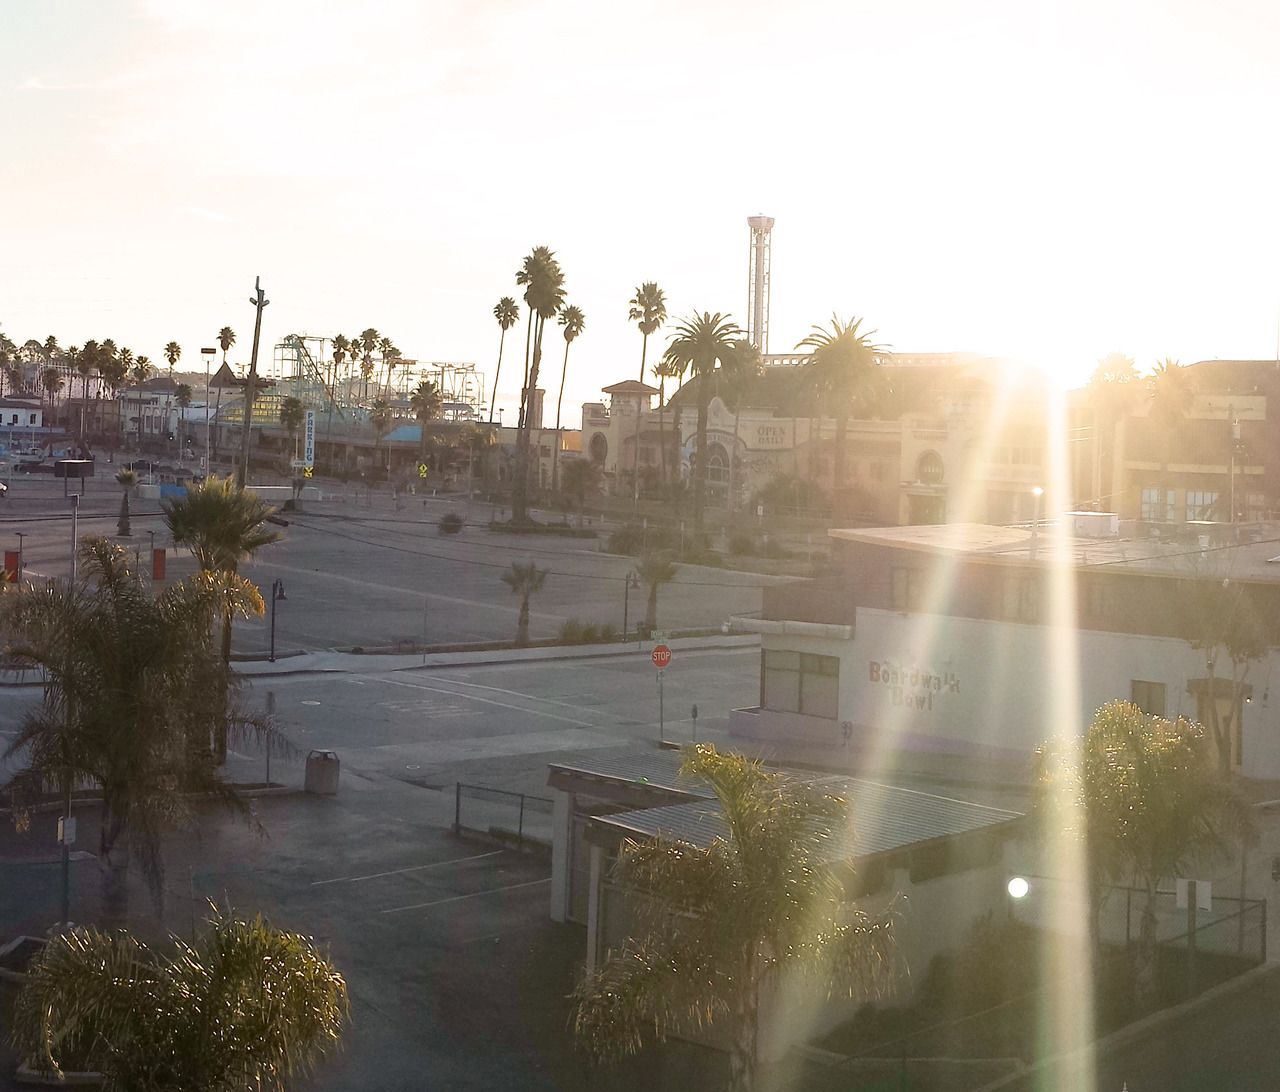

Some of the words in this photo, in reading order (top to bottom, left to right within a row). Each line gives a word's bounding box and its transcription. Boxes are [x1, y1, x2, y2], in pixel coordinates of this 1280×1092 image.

[306, 412, 314, 461] PARKING
[757, 425, 786, 437] OPEN
[757, 437, 785, 445] DAILY
[652, 651, 671, 661] STOP
[869, 661, 961, 693] Boardwalk
[890, 685, 933, 711] Bowl
